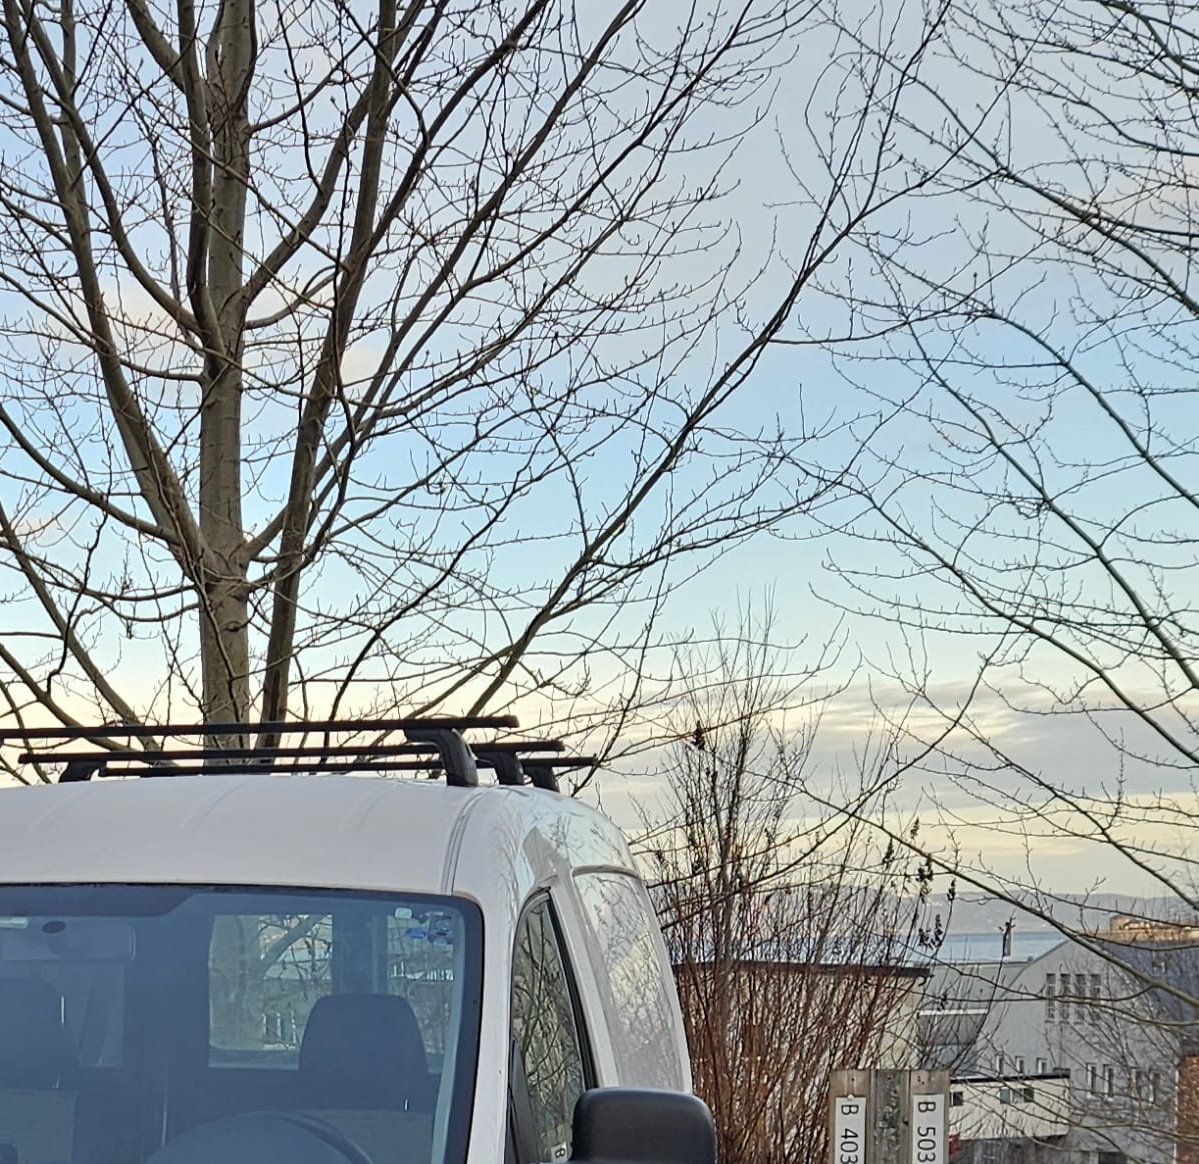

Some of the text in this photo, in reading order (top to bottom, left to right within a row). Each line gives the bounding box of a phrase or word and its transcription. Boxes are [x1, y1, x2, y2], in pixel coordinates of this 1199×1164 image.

[840, 1104, 859, 1164] B 403
[917, 1101, 936, 1163] B 503
